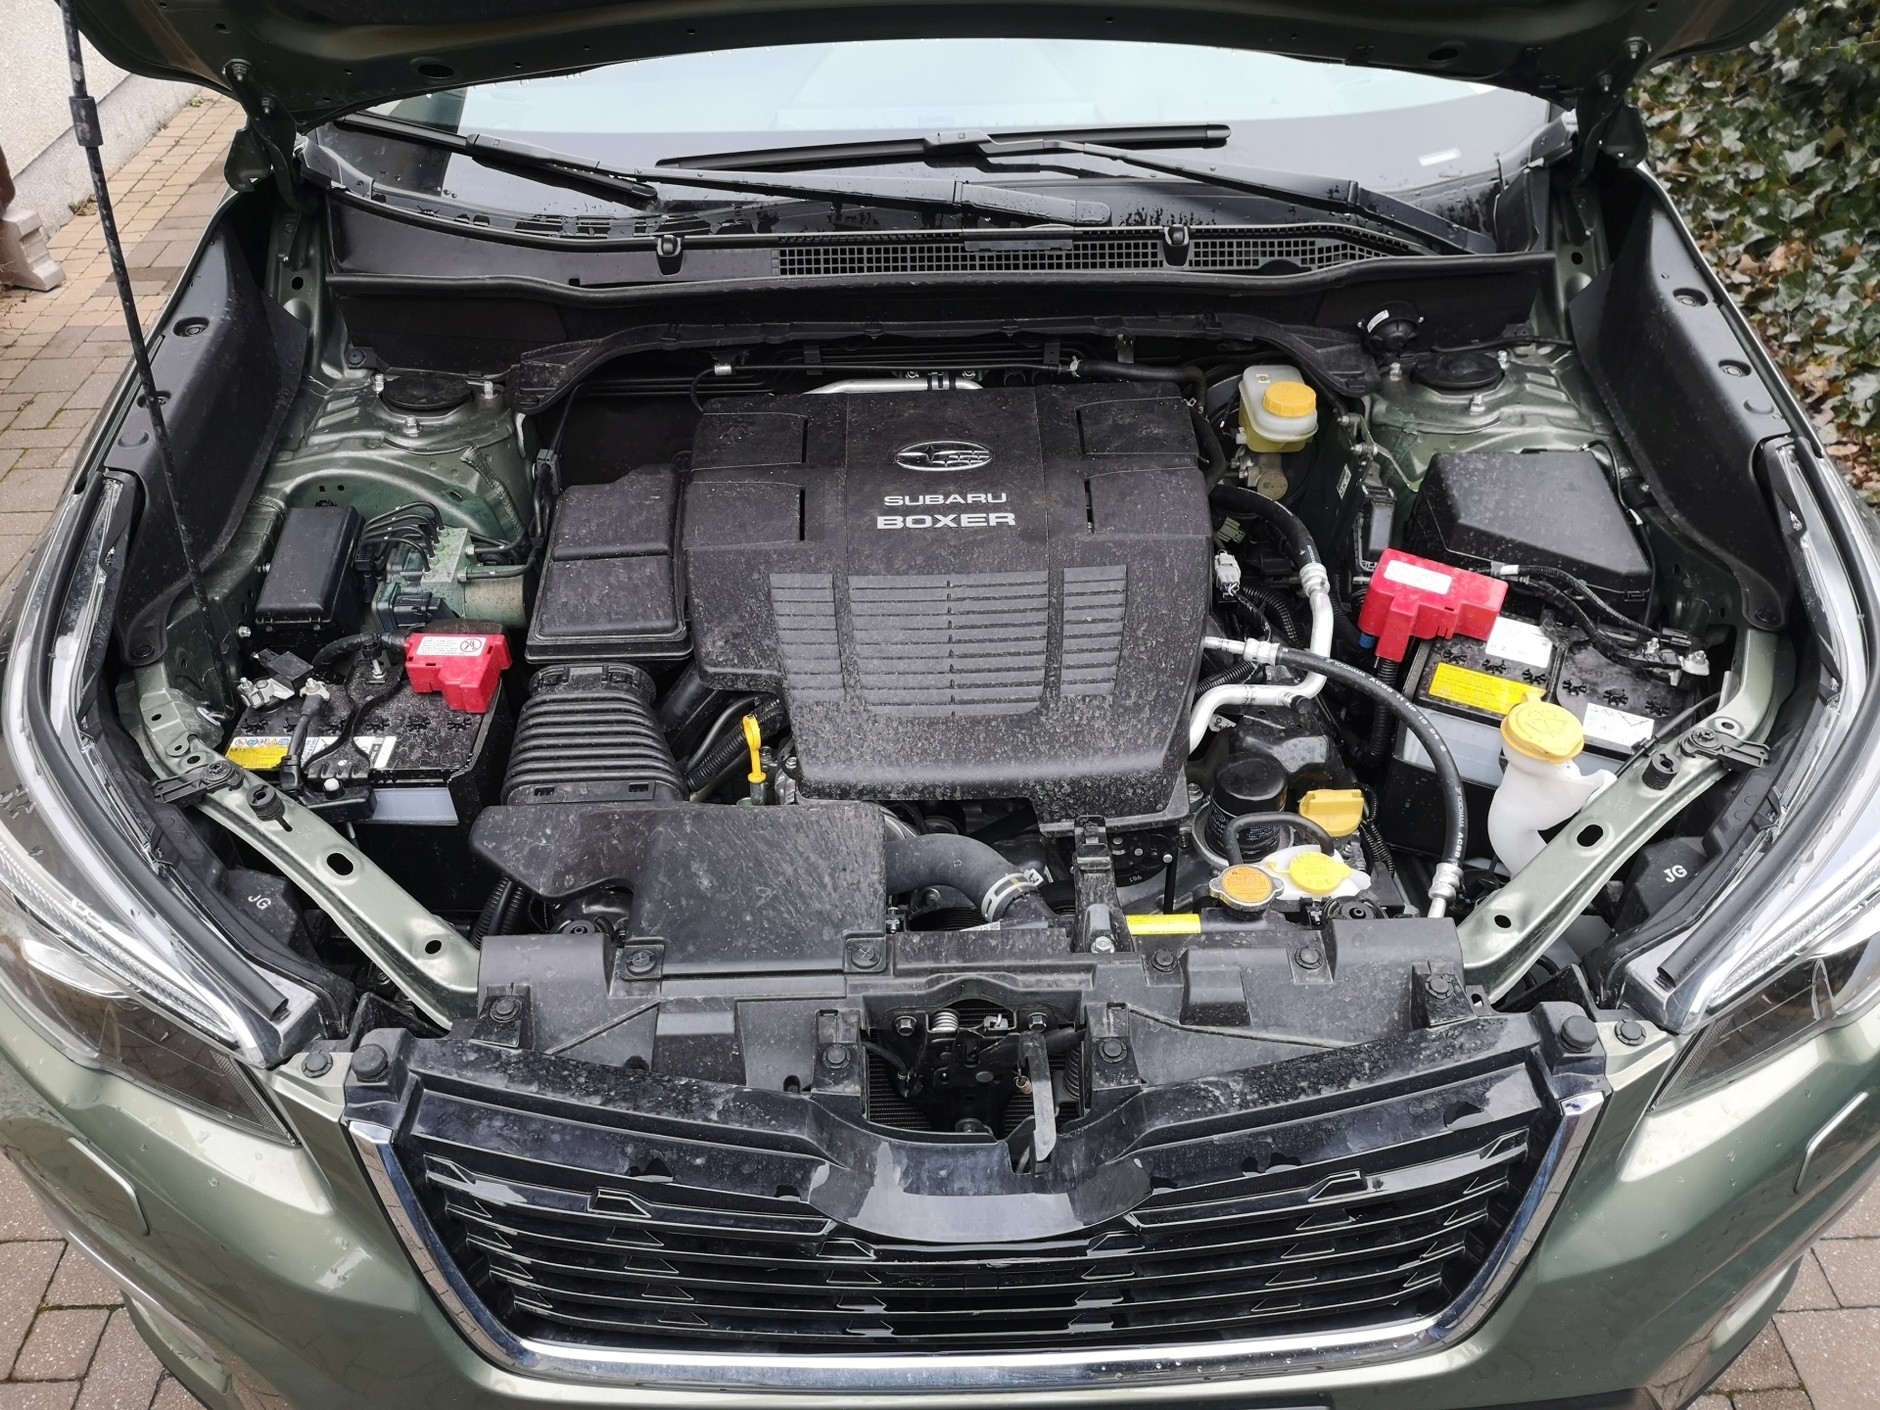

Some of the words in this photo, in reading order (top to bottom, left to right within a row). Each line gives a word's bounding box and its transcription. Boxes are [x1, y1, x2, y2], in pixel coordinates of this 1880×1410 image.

[883, 492, 1007, 506] SUBARU
[876, 512, 1016, 530] BOXER
[1663, 864, 1688, 883] JG
[247, 894, 272, 911] JG
